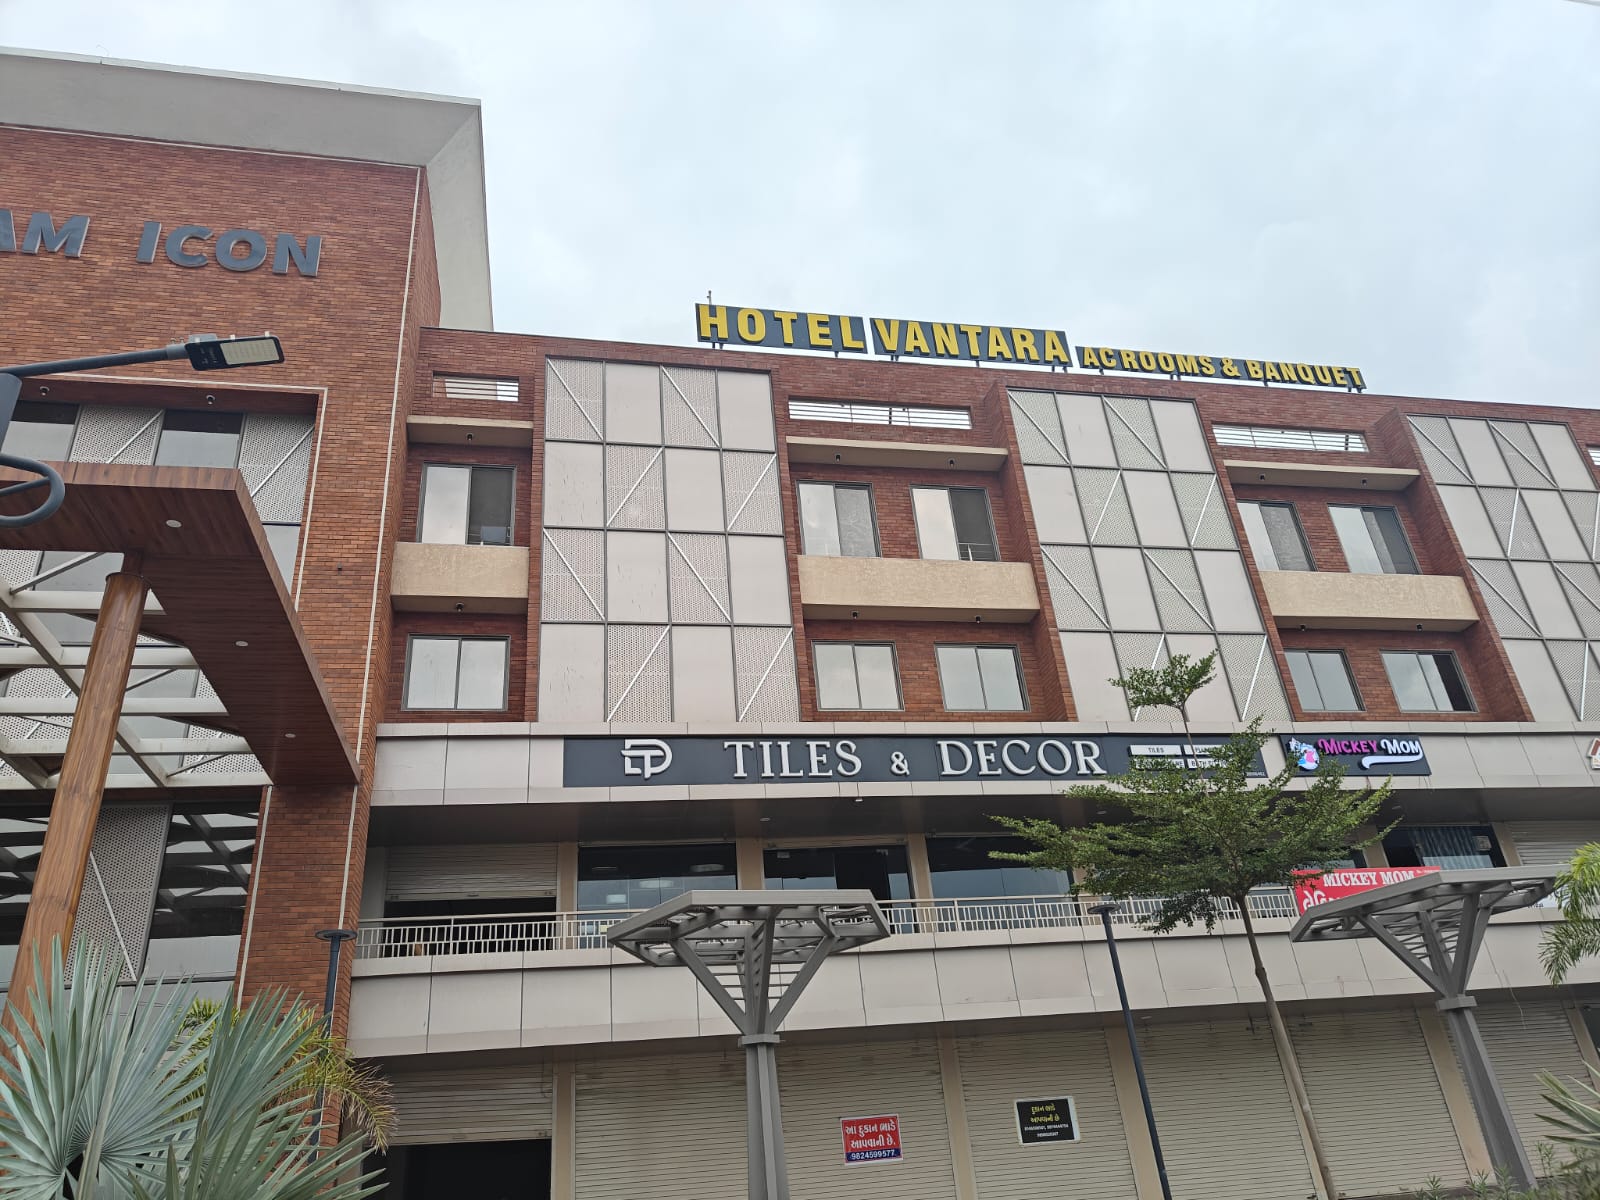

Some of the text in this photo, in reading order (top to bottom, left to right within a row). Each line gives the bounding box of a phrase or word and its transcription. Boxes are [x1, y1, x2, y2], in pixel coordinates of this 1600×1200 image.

[136, 221, 321, 276] ICON
[699, 304, 1068, 363] HOTEL VANTARA
[1083, 347, 1363, 386] AC ROOMS & BANQUET
[724, 739, 1107, 778] TILES & DECOR
[1318, 738, 1378, 755] MICKEY
[1323, 872, 1377, 887] MICKEY
[845, 1119, 896, 1137] આ દુકાન ભાડે
[851, 1134, 885, 1149] આપવાની
